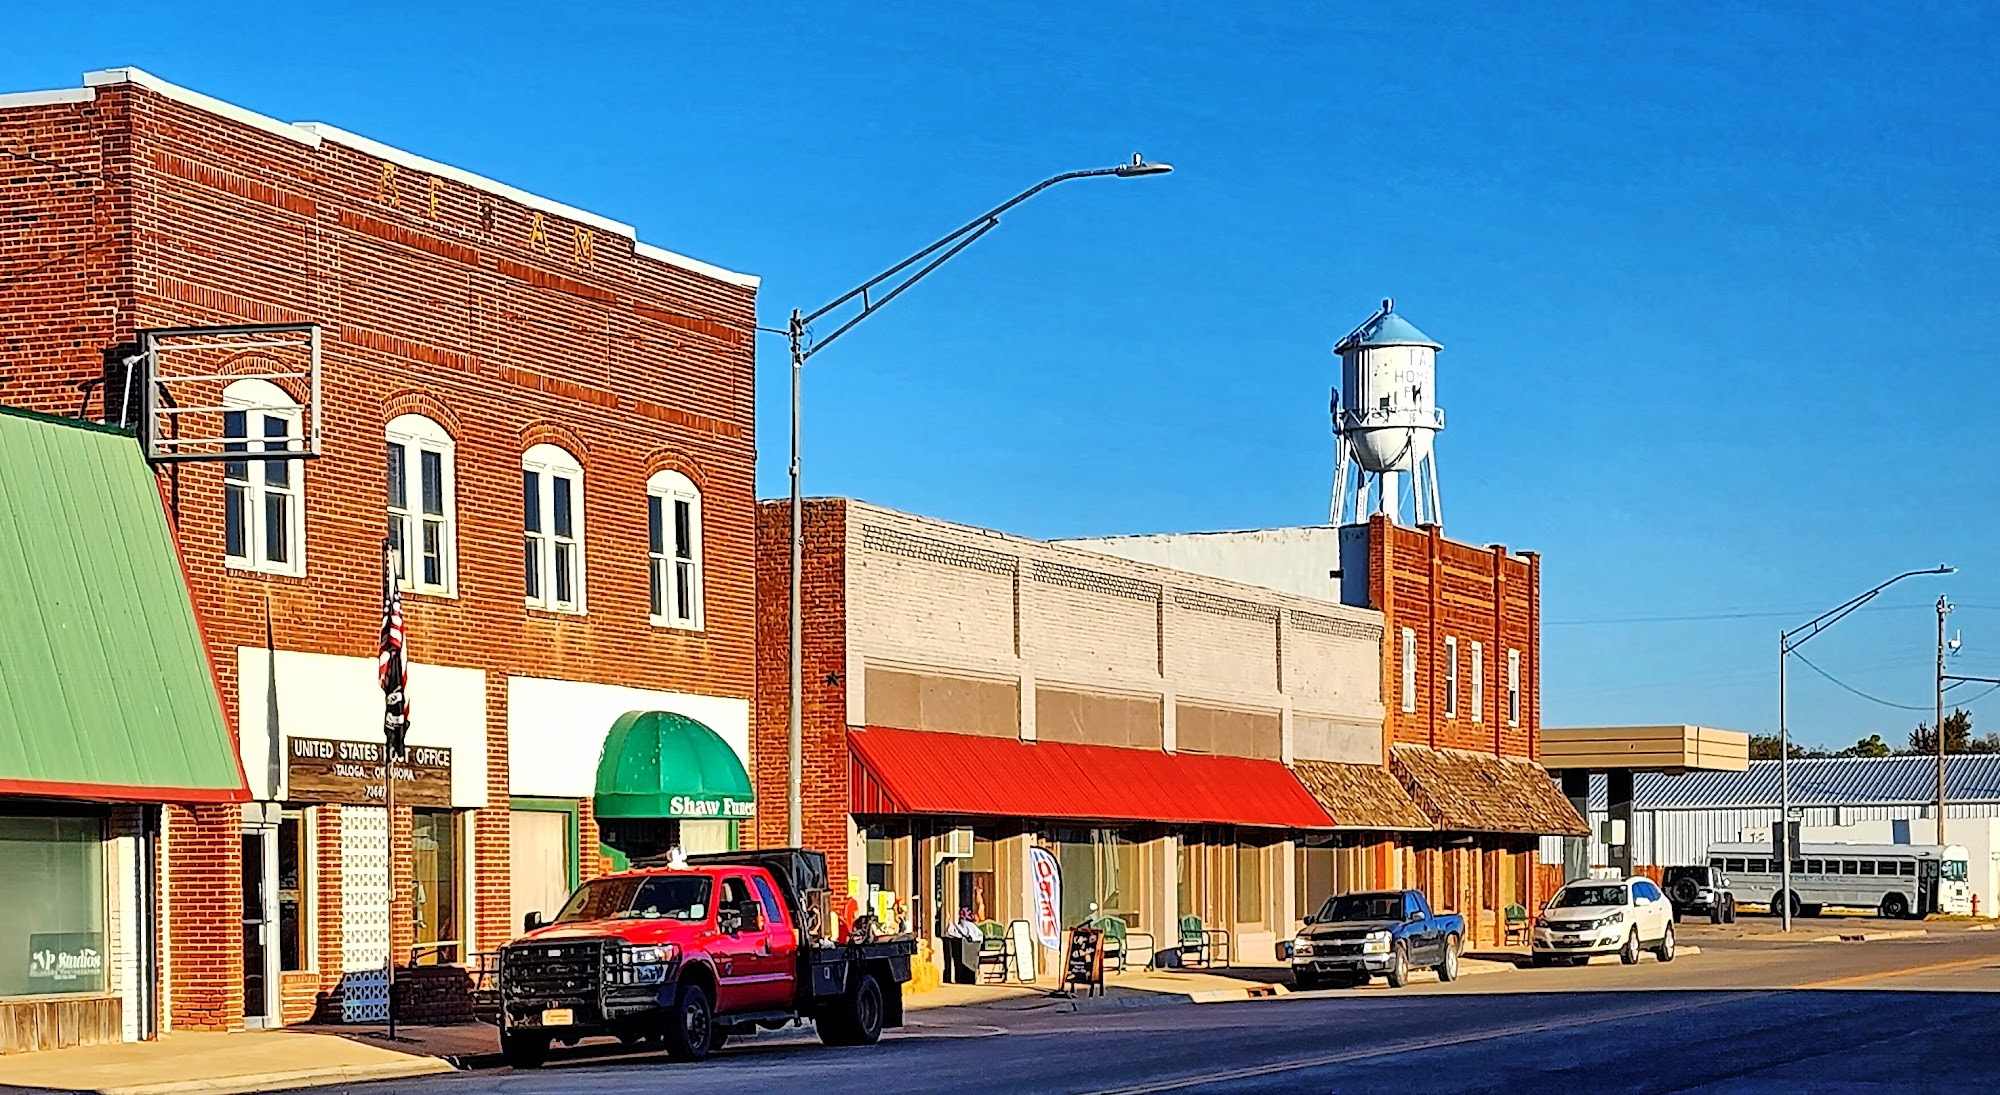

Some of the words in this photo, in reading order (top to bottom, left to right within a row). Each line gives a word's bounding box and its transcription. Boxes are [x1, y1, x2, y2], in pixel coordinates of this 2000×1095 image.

[294, 739, 334, 759] UNITED
[339, 742, 378, 762] STATES
[416, 748, 450, 767] OFFICE
[670, 796, 720, 815] Shaw
